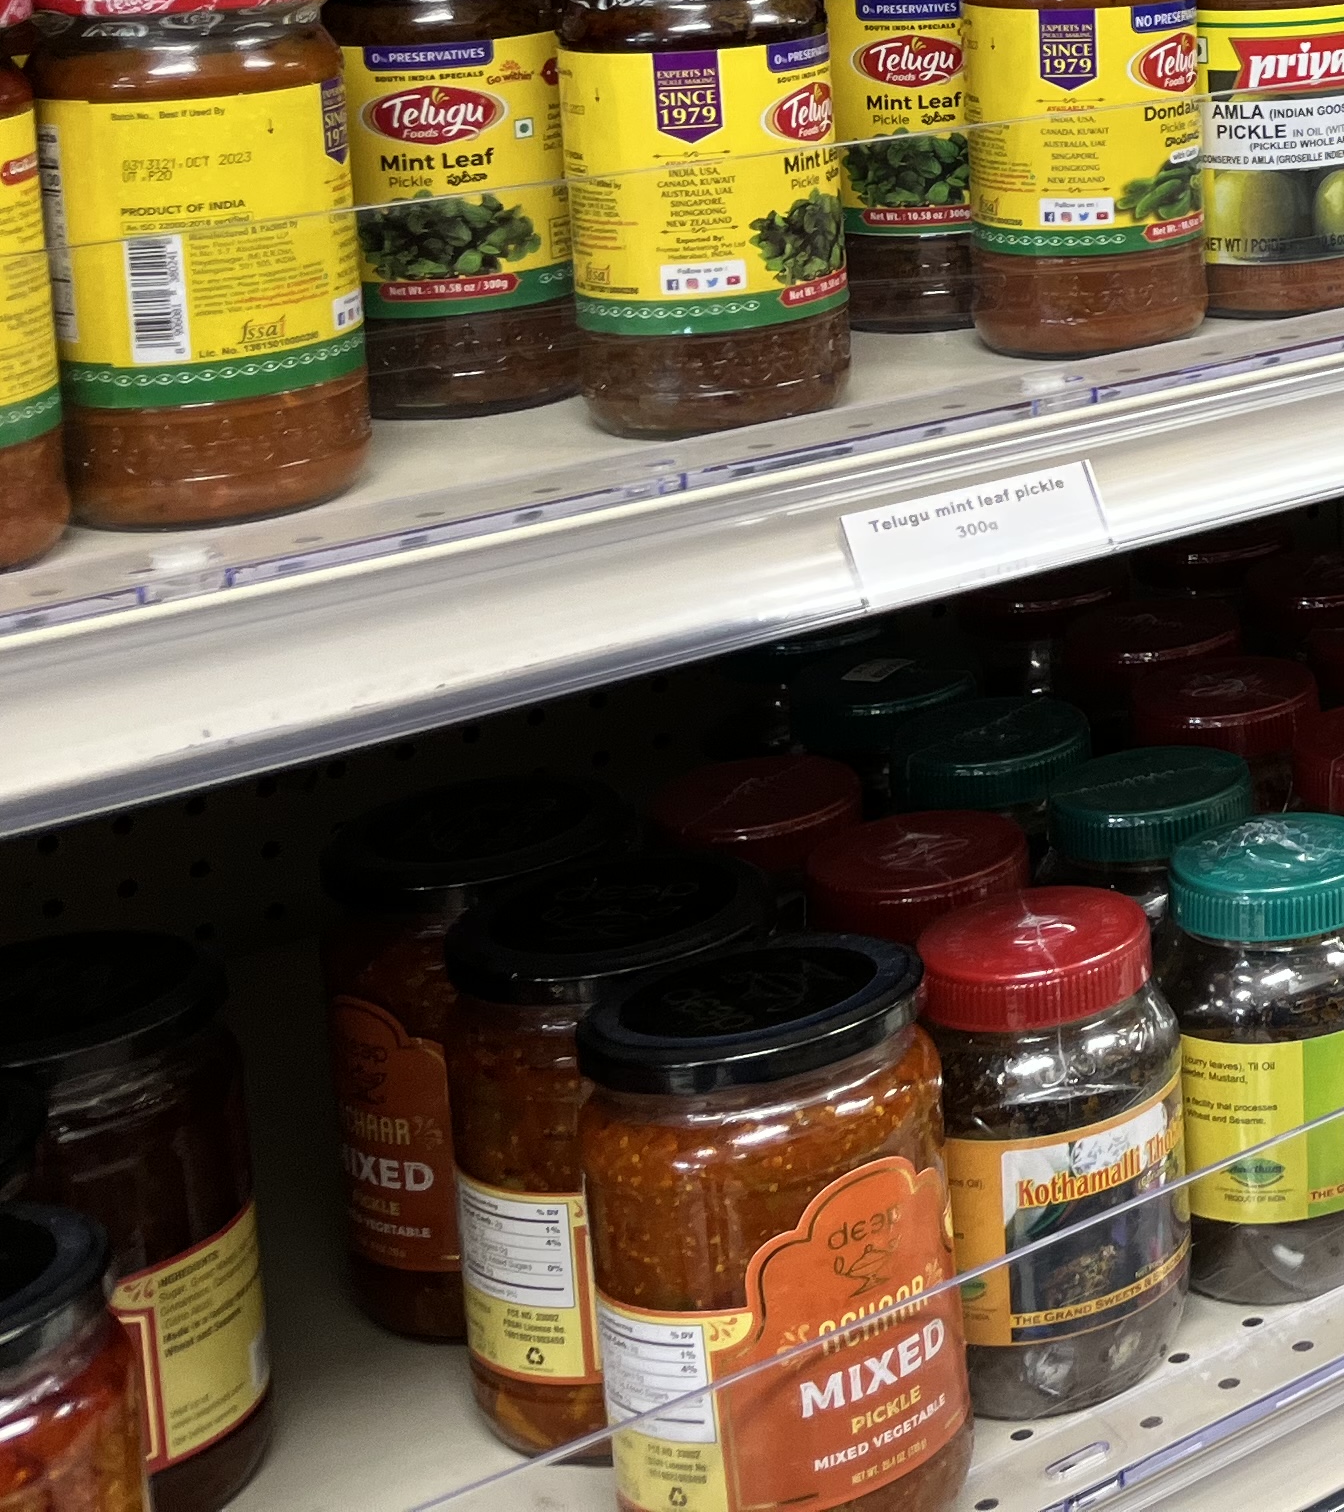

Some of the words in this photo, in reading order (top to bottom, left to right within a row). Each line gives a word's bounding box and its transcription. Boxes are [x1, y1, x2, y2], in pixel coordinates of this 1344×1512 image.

[868, 44, 956, 75] Telugu
[1042, 44, 1092, 59] SINCE
[885, 72, 917, 82] Foods
[1043, 58, 1092, 76] 1979
[659, 90, 718, 107] SINCE
[866, 93, 911, 111] Mint
[917, 91, 963, 109] Leaf
[381, 94, 488, 134] Telugu
[660, 105, 718, 125] 1979
[872, 112, 911, 125] Pickle
[1212, 101, 1265, 120] AMLA
[1269, 104, 1307, 122] (INDIAN
[403, 126, 440, 140] Foods
[1216, 123, 1288, 142] PICKLE
[1292, 127, 1304, 138] IN
[1306, 126, 1324, 138] OIL
[218, 151, 252, 166] 2023
[380, 151, 435, 172] Mint
[441, 148, 494, 169] Leaf
[388, 174, 434, 189] Pickle
[120, 204, 183, 217] PRODUCT
[186, 203, 205, 214] OF
[209, 199, 246, 212] INDIA
[868, 510, 930, 534] Telugu
[935, 498, 974, 518] mint
[977, 489, 1010, 508] leaf
[1015, 477, 1065, 503] pickle
[1017, 1146, 1143, 1209] Kothamalli
[1015, 1314, 1040, 1327] THE
[1042, 1303, 1094, 1326] GRAND
[1095, 1282, 1145, 1314] SWEETS
[800, 1320, 946, 1419] MIXED
[851, 1386, 922, 1435] PICKLE
[814, 1434, 868, 1472] MIXED
[873, 1394, 946, 1449] VEGETABLE
